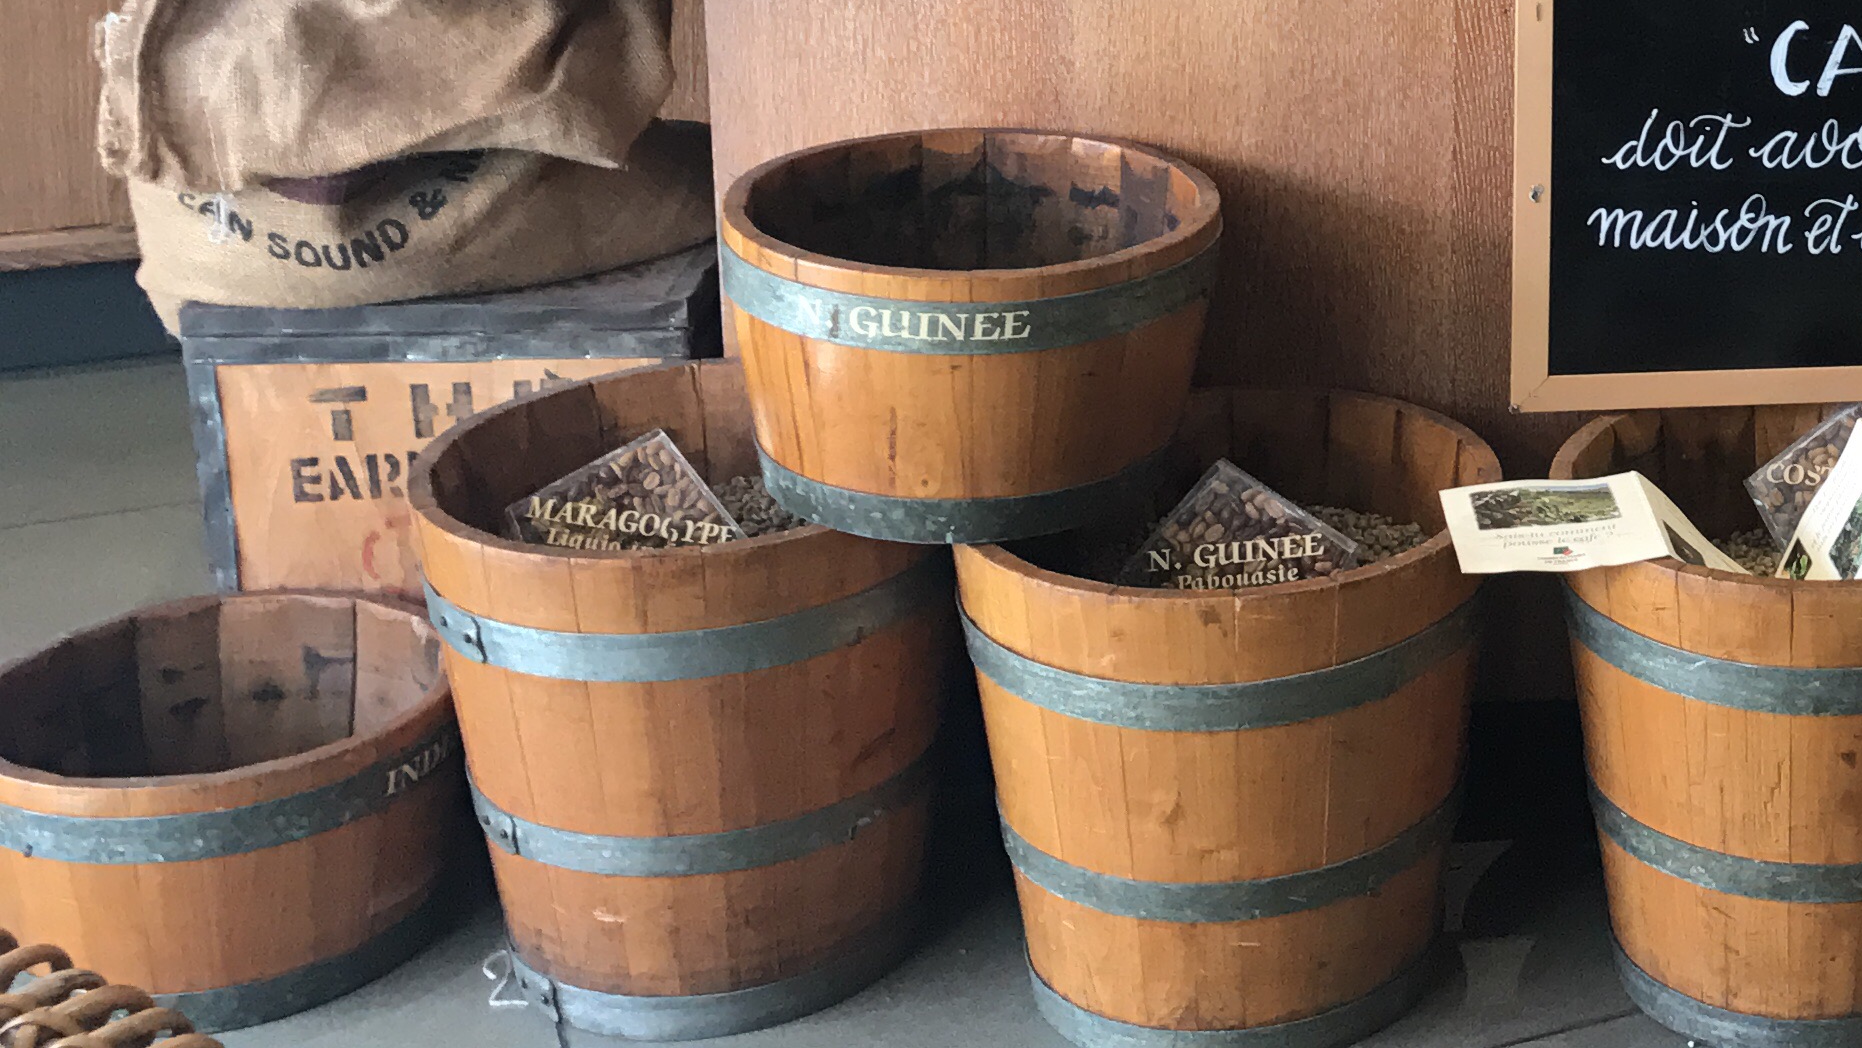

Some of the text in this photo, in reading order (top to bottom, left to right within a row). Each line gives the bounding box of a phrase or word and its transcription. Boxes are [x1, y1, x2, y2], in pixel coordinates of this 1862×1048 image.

[1601, 108, 1751, 173] doit
[267, 218, 409, 271] SOUND
[408, 188, 449, 220] &
[1588, 195, 1815, 255] maison
[1804, 200, 1856, 255] et
[848, 305, 1032, 343] GUINEE
[291, 451, 421, 503] EAR
[1194, 533, 1324, 569] GUINEE
